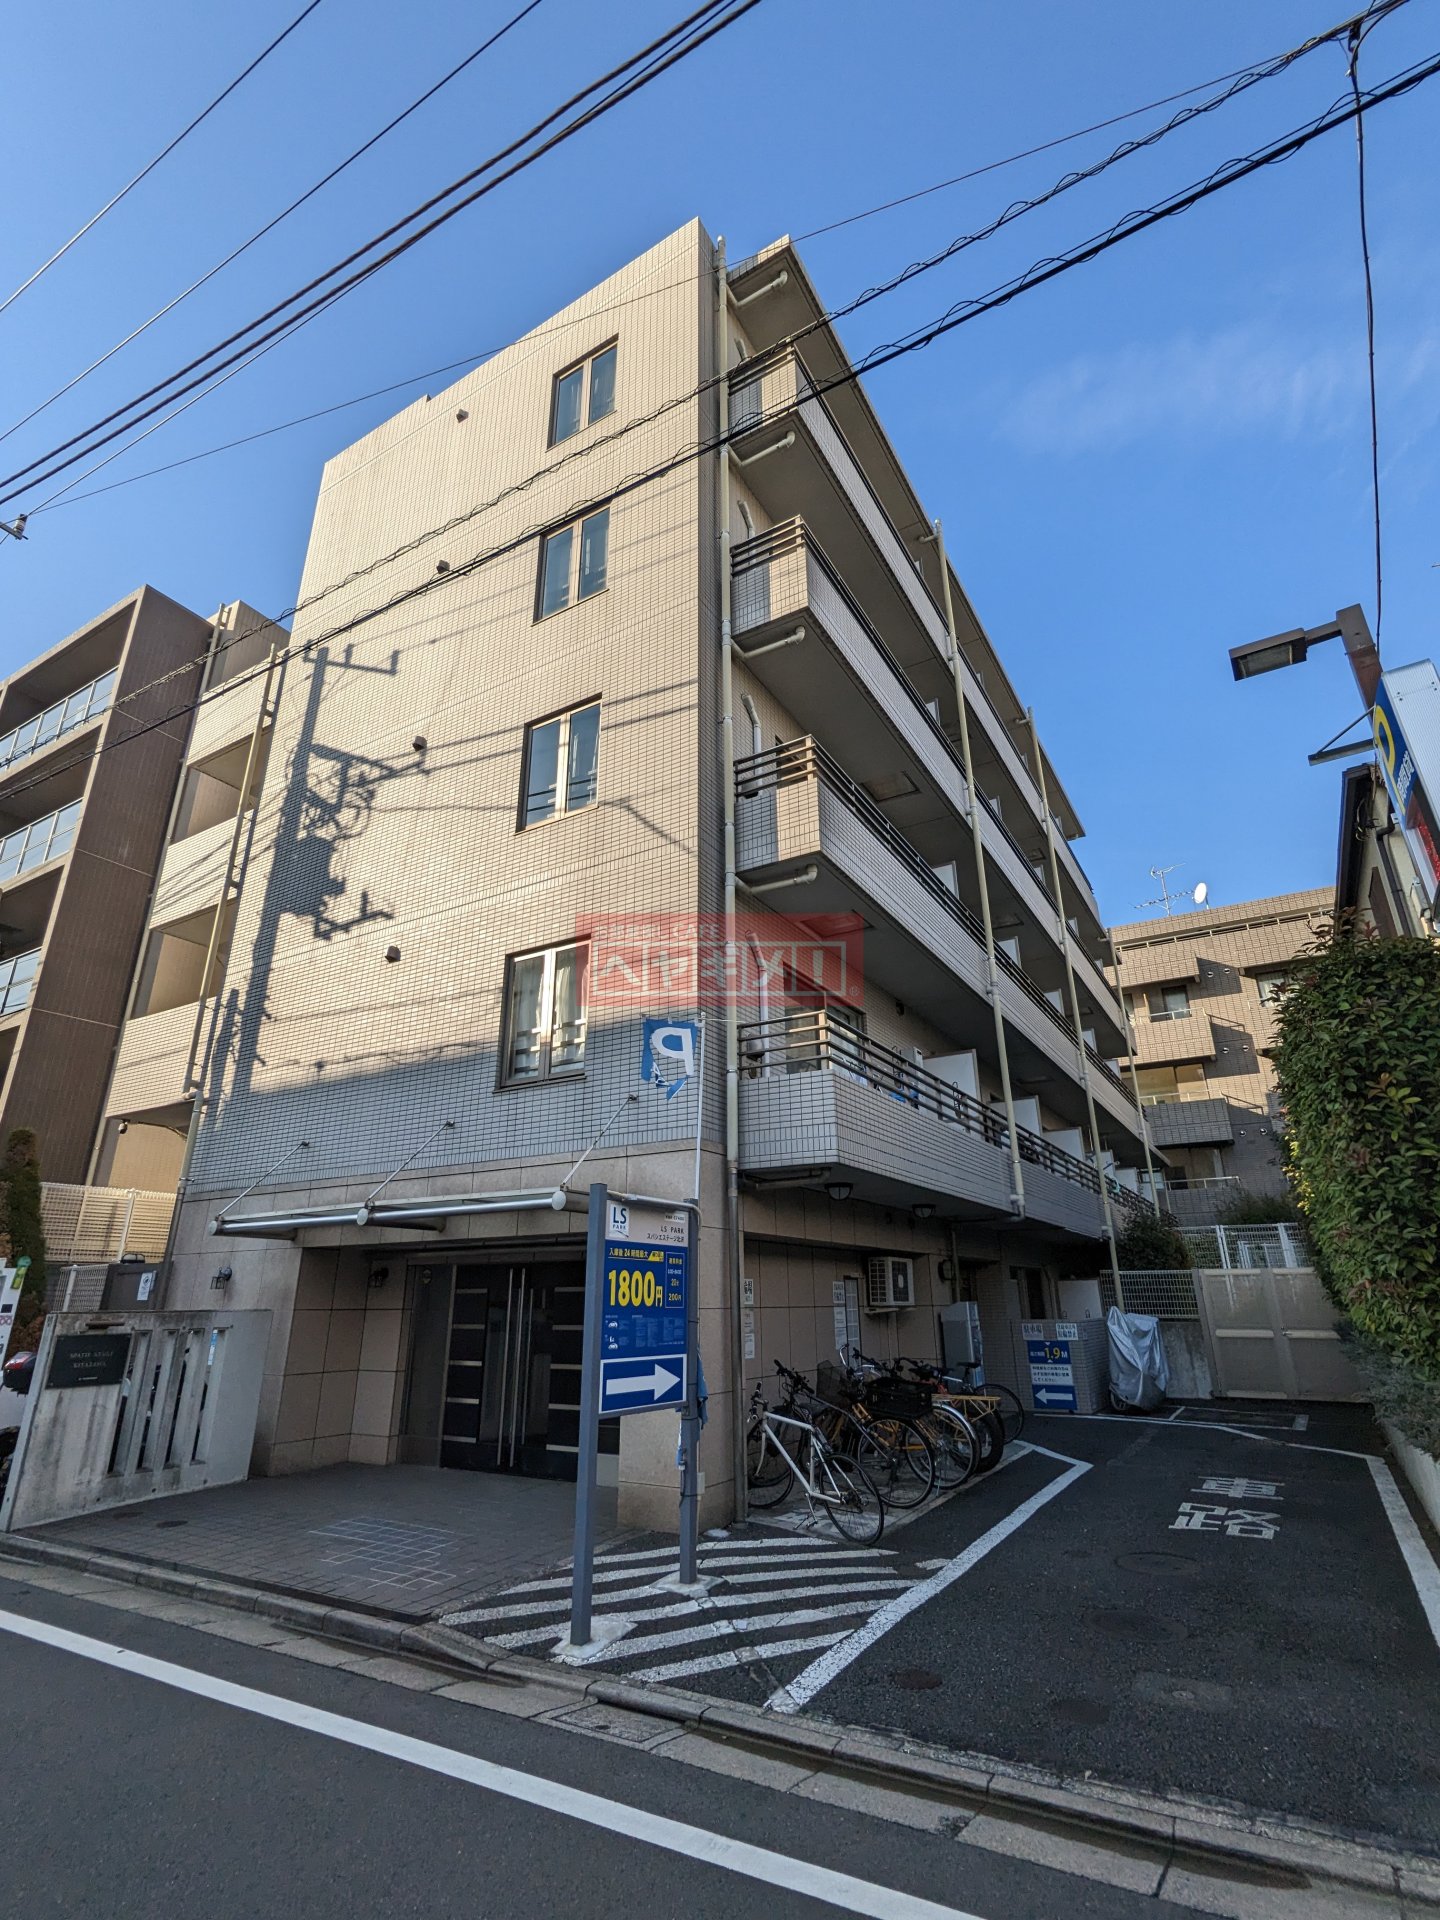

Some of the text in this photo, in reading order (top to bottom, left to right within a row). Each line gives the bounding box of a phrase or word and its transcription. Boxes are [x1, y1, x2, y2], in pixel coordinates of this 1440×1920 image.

[613, 1206, 627, 1224] LS
[670, 1226, 684, 1234] PARK
[608, 1269, 663, 1307] 1800円
